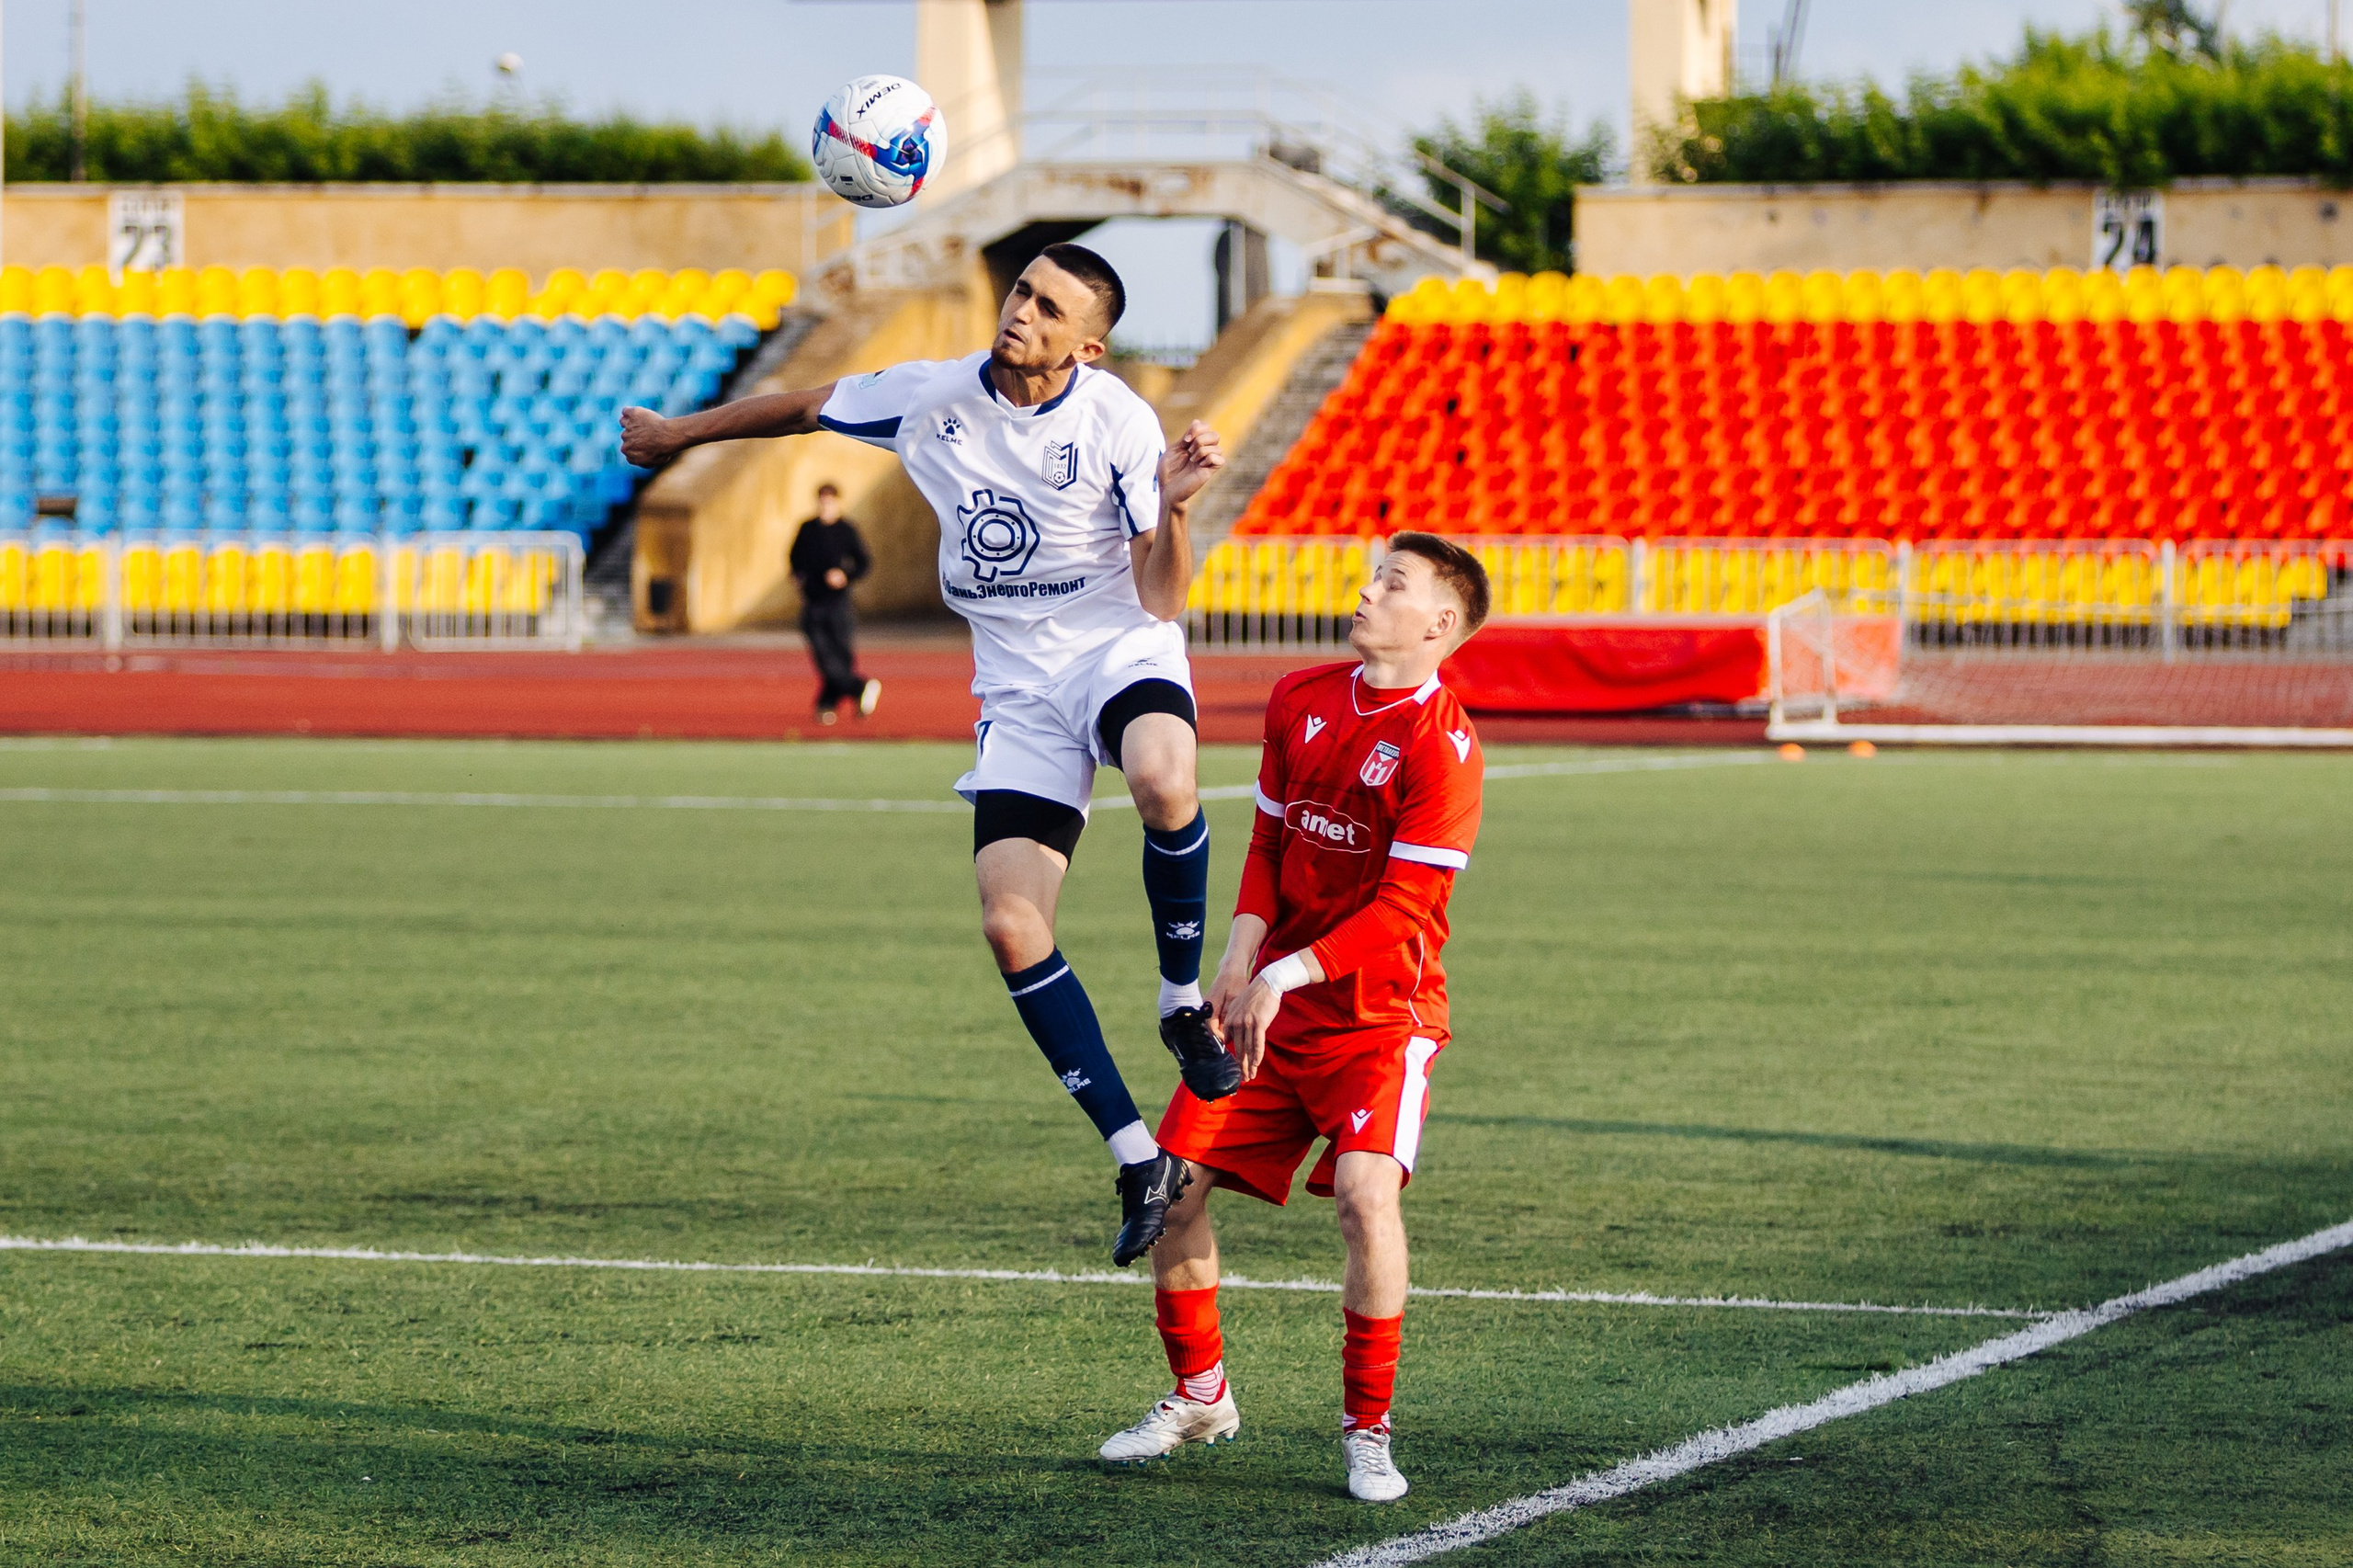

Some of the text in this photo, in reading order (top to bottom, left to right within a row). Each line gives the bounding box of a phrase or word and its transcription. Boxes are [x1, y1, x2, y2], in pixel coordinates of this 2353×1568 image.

[857, 83, 902, 119] DEMIX
[936, 433, 963, 446] KELME
[1301, 810, 1355, 846] amet
